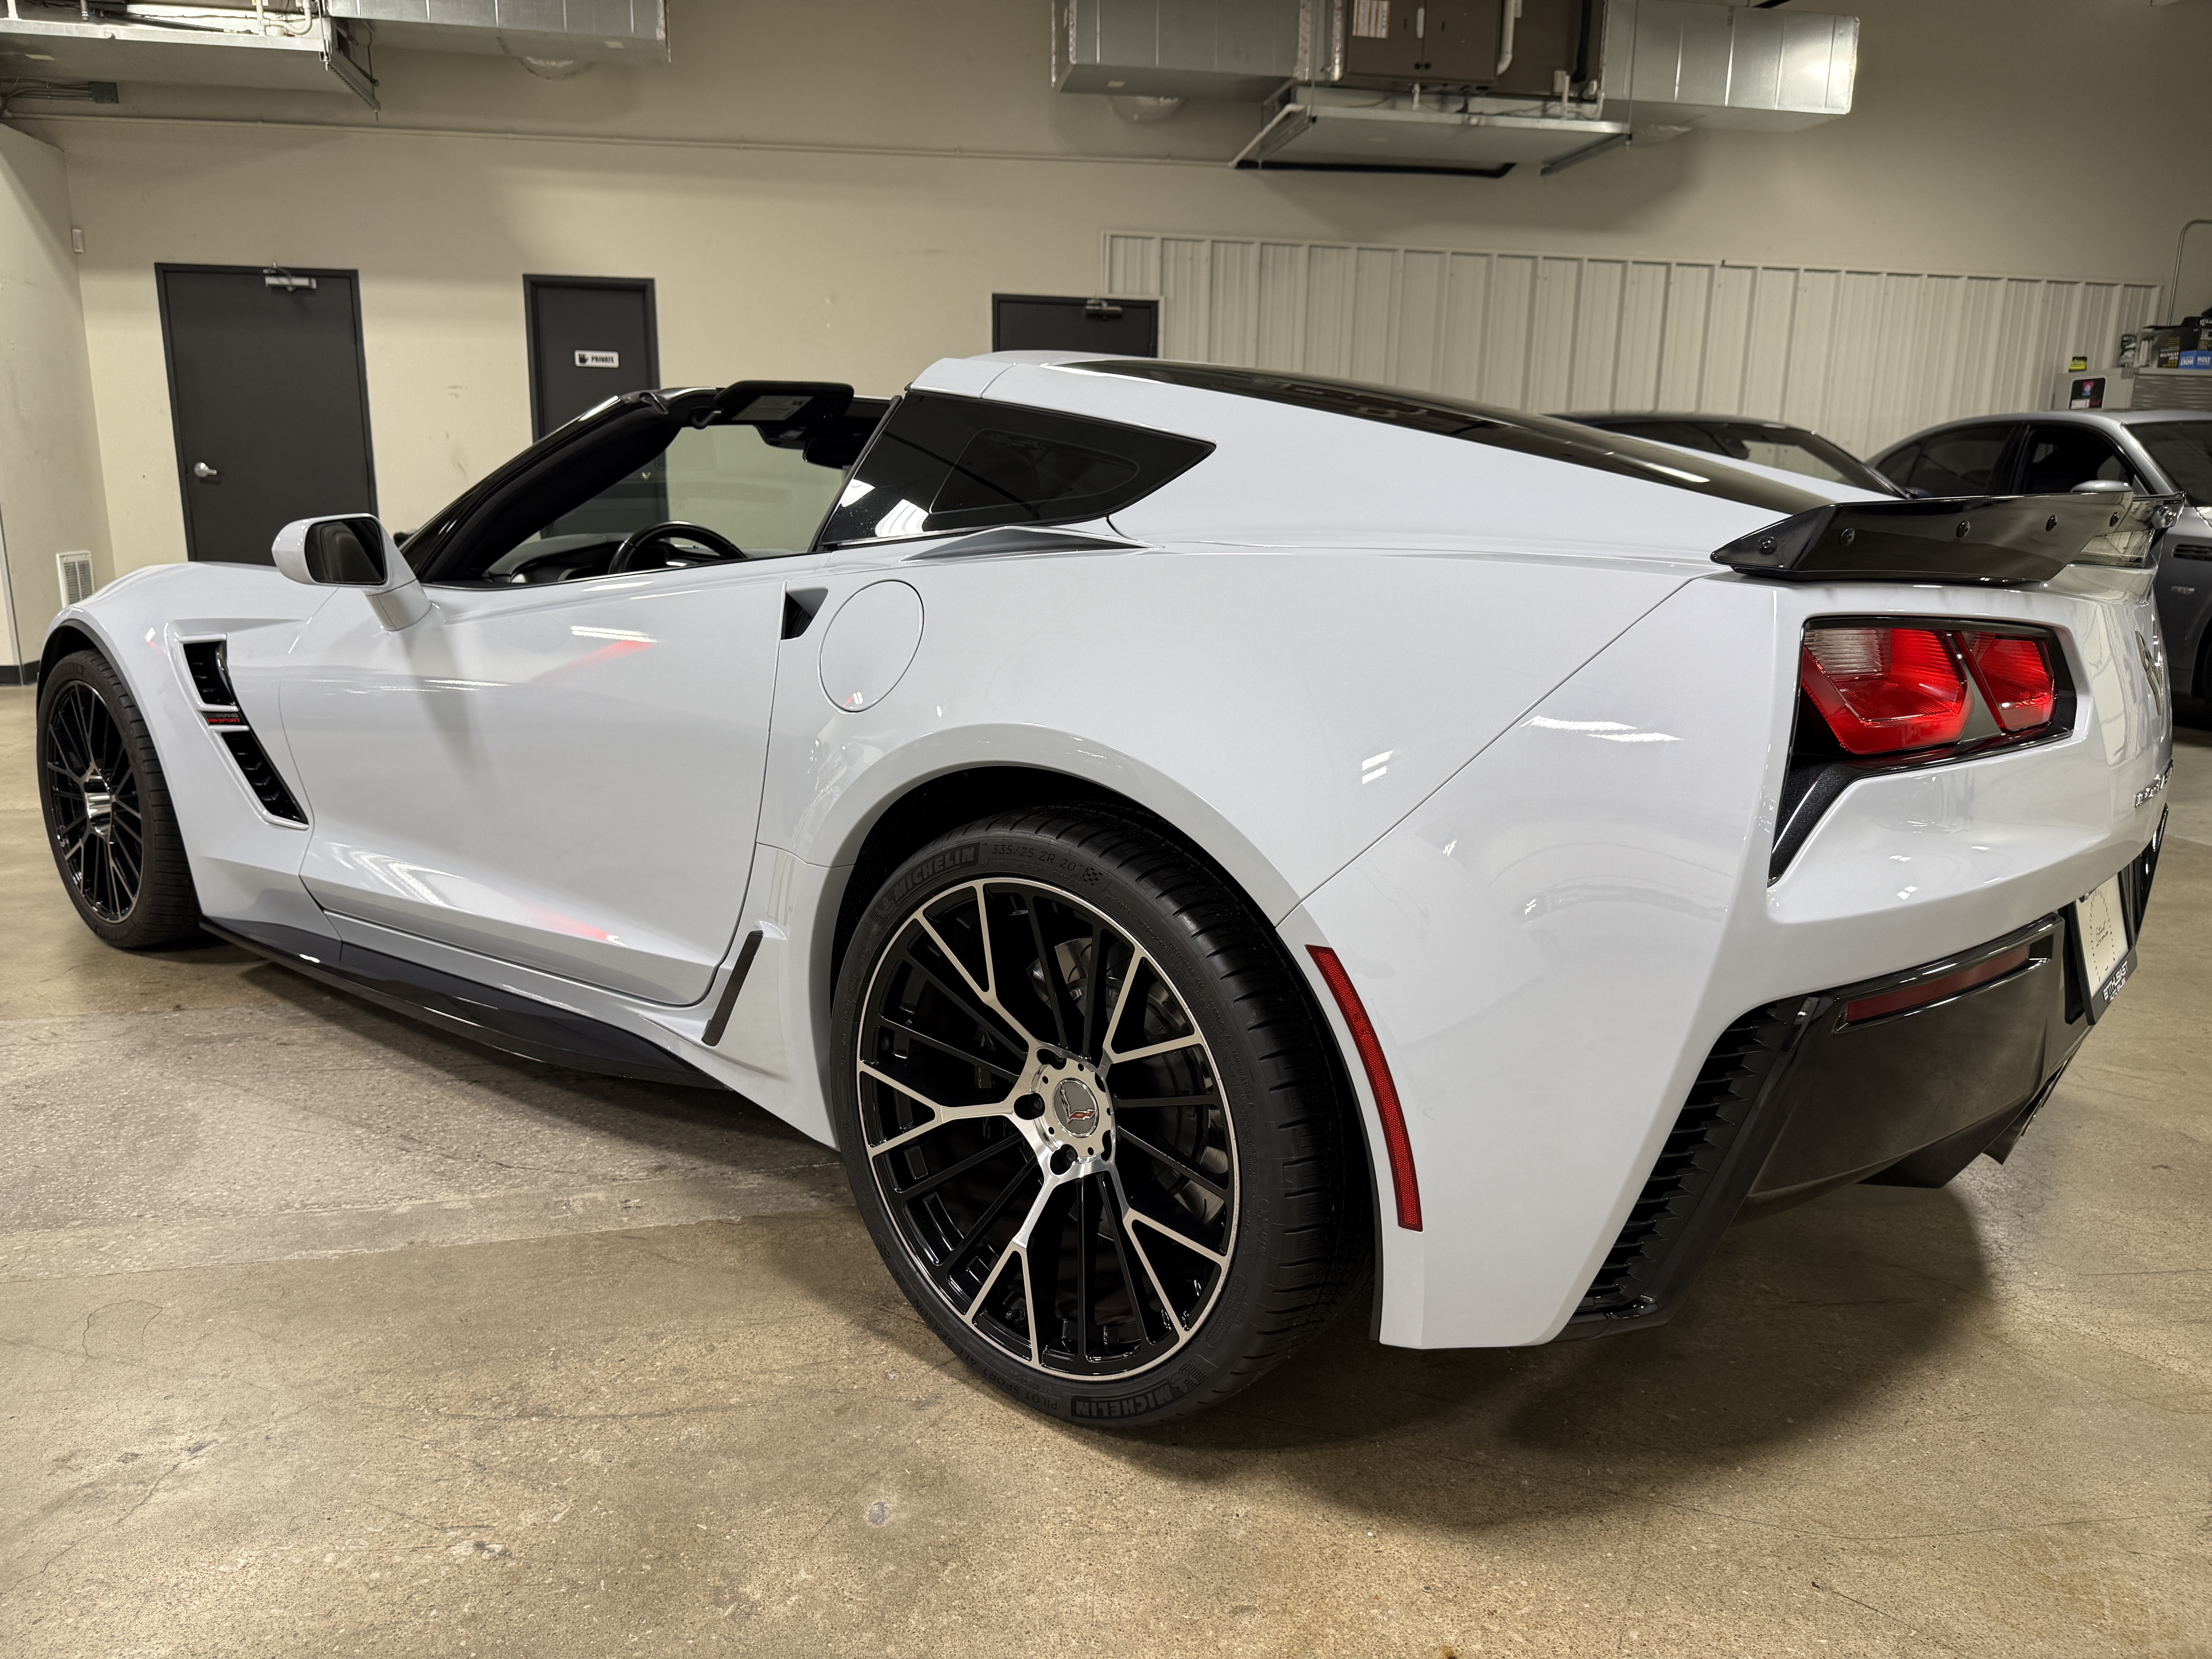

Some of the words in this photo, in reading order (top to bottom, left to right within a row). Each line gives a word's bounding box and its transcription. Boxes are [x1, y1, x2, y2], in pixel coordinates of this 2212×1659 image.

[591, 355, 614, 363] PRIVATE
[991, 844, 1036, 858] 335/25
[1039, 850, 1056, 864] ZR
[1060, 858, 1076, 871] 20
[893, 847, 975, 901] MICHELIN
[1136, 917, 1173, 959] INSTRUCTIONS
[1167, 939, 1195, 976] TREADWEAR
[1208, 998, 1227, 1030] TRACTION
[1230, 1047, 1252, 1097] TEMPERATURE
[913, 1298, 954, 1346] SEASON
[957, 1347, 977, 1365] ALL
[982, 1367, 1020, 1394] SPORT
[1025, 1392, 1058, 1410] PILOT
[1075, 1384, 1174, 1416] MICHELIN
